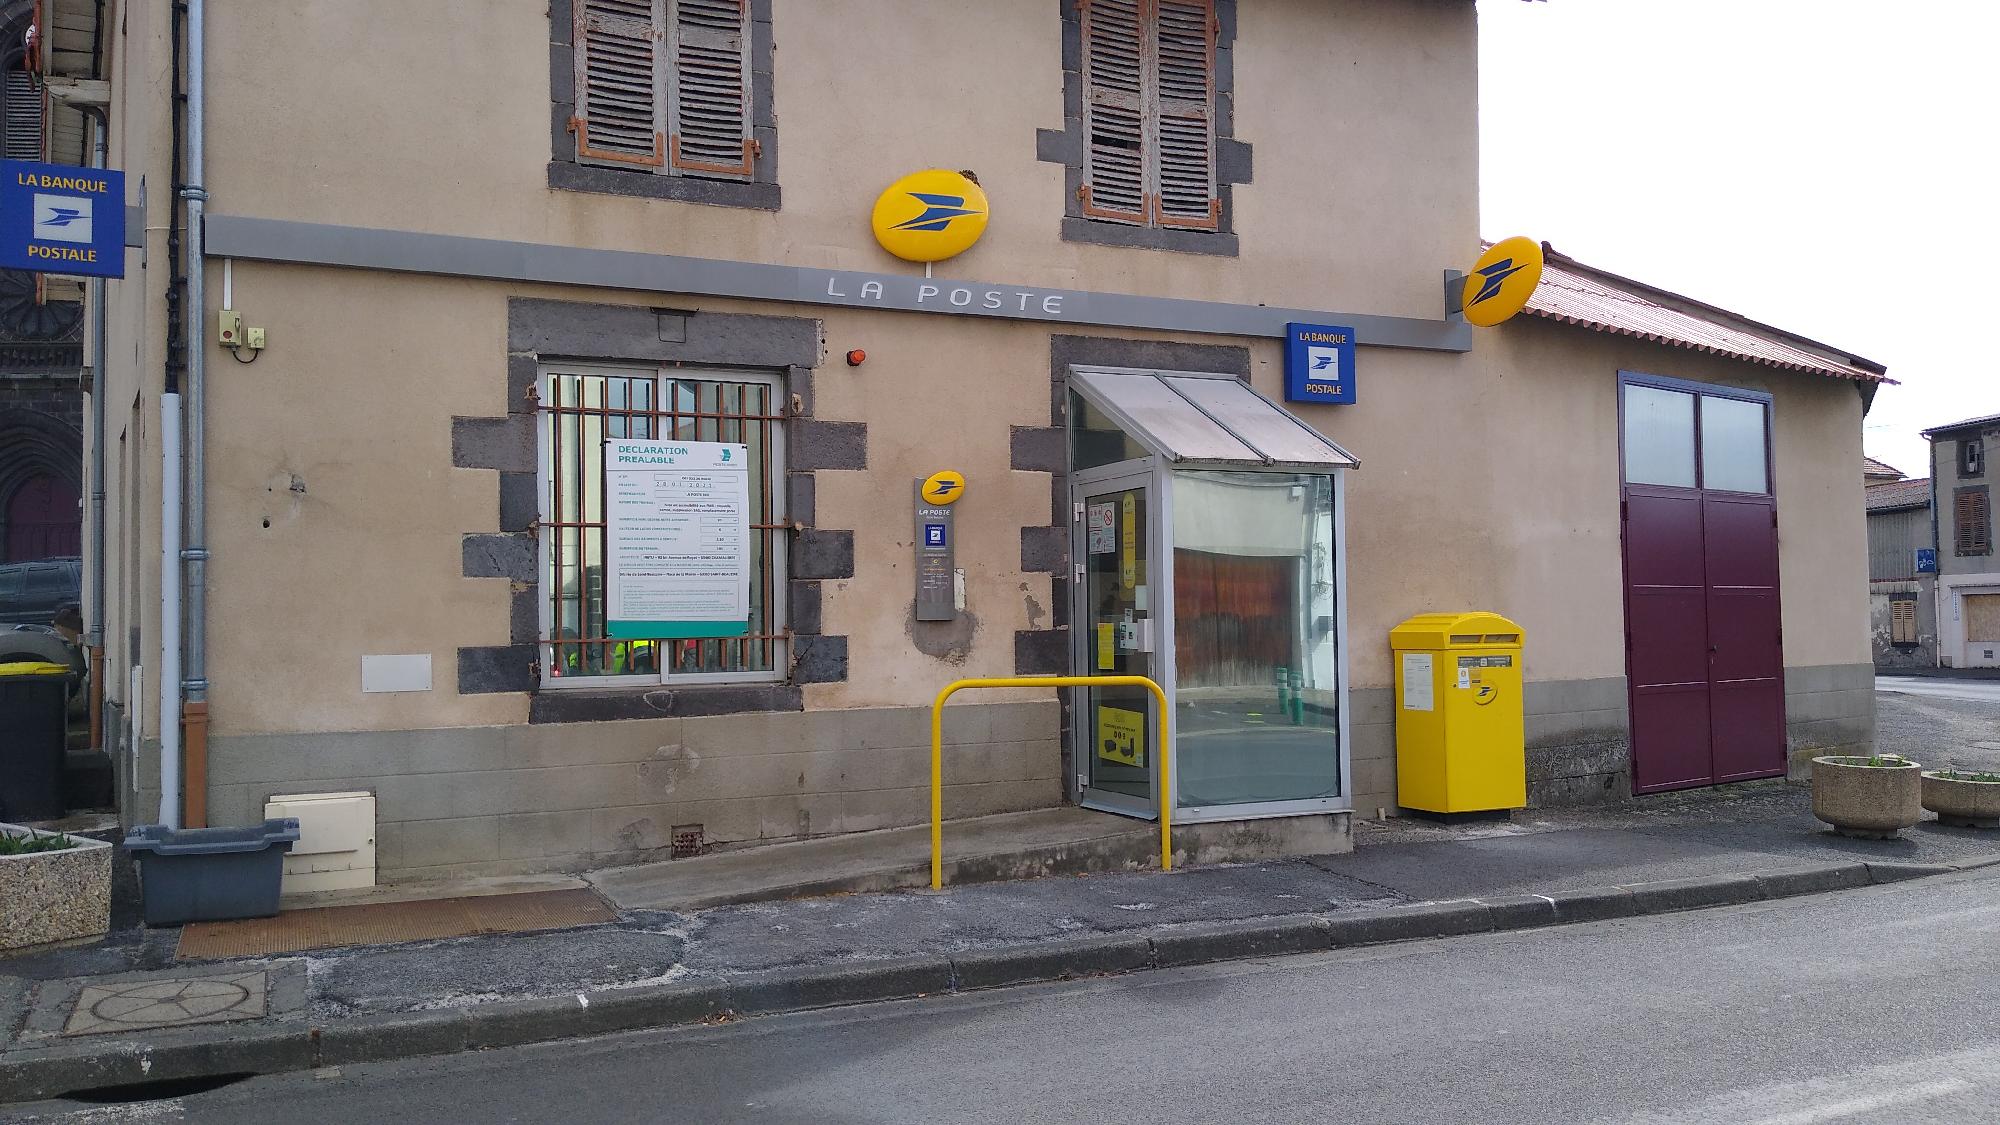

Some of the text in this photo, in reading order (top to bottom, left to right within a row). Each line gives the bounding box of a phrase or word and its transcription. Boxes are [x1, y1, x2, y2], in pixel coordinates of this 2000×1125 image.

[18, 172, 108, 193] LA BANQUE
[28, 245, 97, 262] POSTALE
[827, 277, 1064, 314] LA POSTE
[1300, 332, 1347, 344] LA BANQUE
[1306, 384, 1342, 394] POSTALE
[618, 445, 689, 455] DECLARATION
[618, 455, 675, 464] PREALABLE
